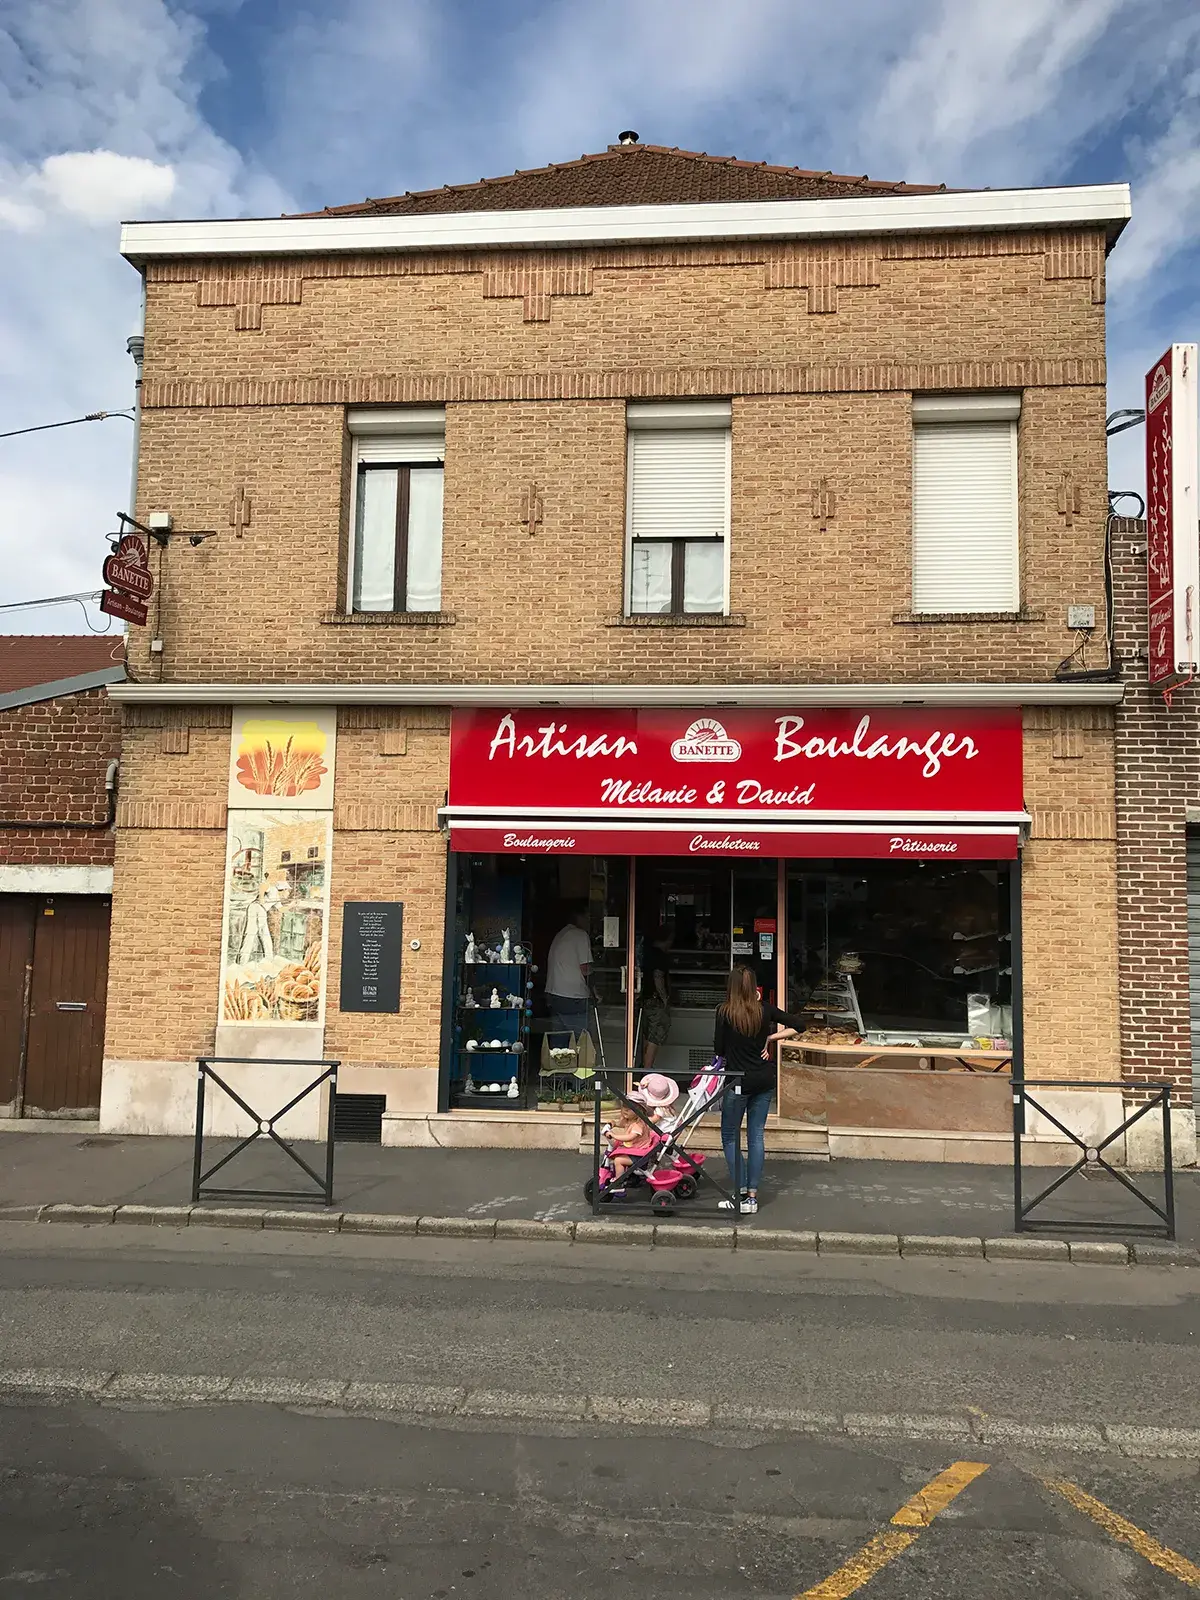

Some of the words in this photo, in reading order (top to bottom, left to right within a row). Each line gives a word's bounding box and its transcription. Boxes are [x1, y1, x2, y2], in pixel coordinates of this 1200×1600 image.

[1150, 381, 1169, 407] BANETTE
[1149, 436, 1159, 573] Artisan
[1159, 407, 1172, 588] Boulanger
[112, 564, 149, 590] BANETTE
[107, 598, 123, 610] Artisan
[125, 604, 146, 619] Boulanger
[1157, 626, 1166, 658] &
[1154, 660, 1169, 678] David
[488, 713, 638, 760] Artisan
[773, 714, 979, 778] Boulanger
[679, 741, 734, 756] BANETTE
[600, 778, 698, 804] Mélanie
[706, 781, 726, 804] &
[736, 779, 816, 805] David
[503, 833, 576, 852] Boulangerie
[689, 834, 761, 852] Caucheteux
[889, 837, 958, 853] Pâtisserie
